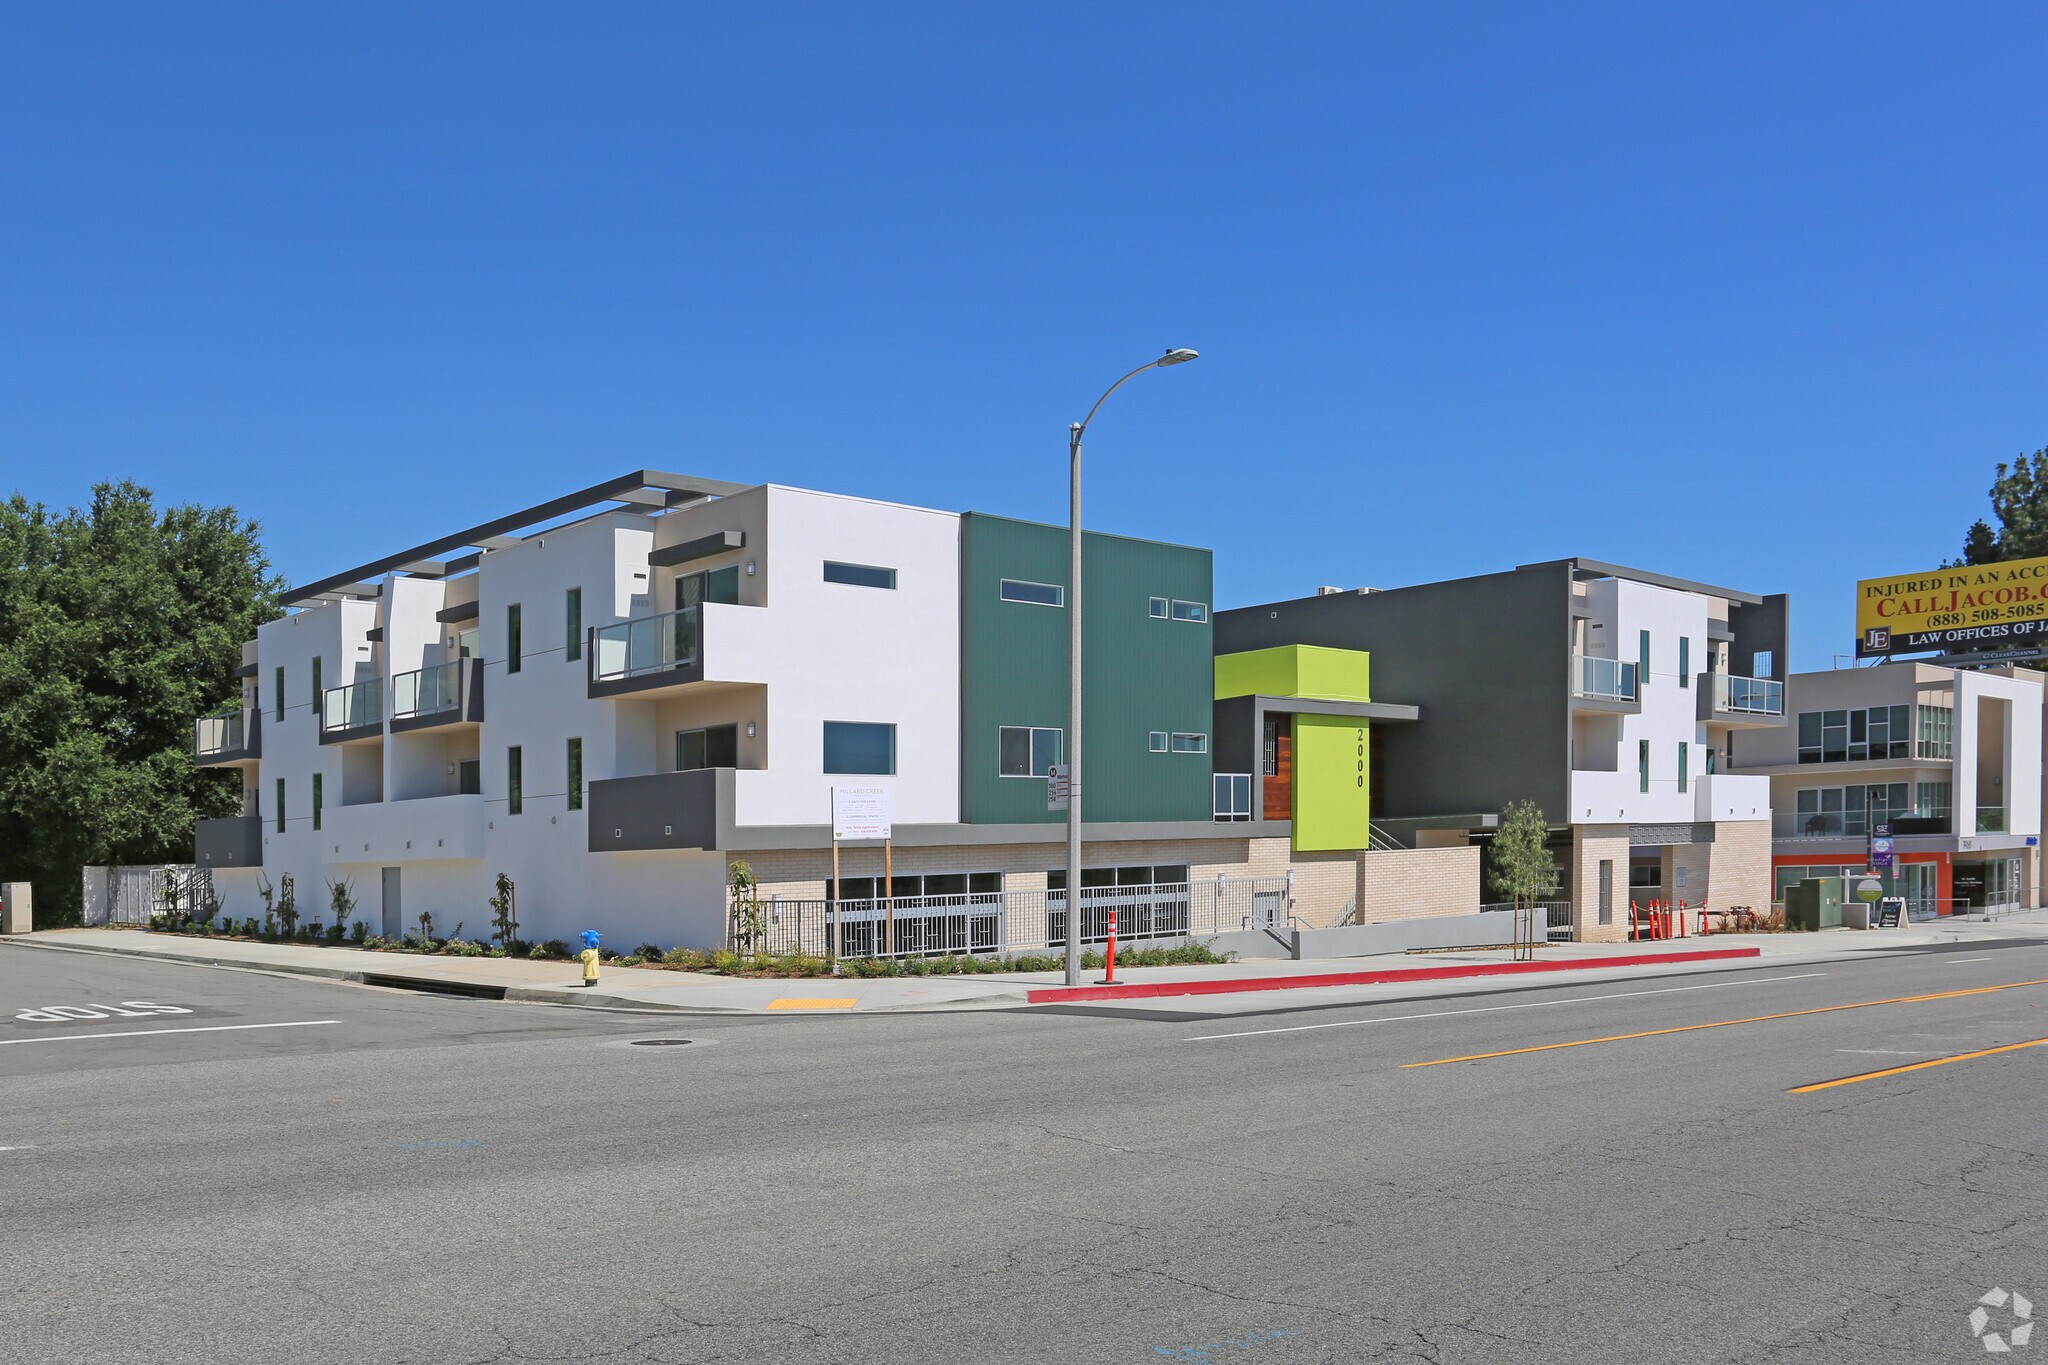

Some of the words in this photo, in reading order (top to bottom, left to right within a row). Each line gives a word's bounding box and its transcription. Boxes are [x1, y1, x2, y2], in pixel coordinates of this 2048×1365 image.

[1866, 579, 1942, 598] INJURED
[1949, 575, 1968, 588] IN
[1974, 571, 2000, 585] AN
[1926, 612, 1966, 629] (888)
[1971, 603, 2045, 623] 508-5085
[1908, 631, 1943, 645] LAW
[1946, 624, 2009, 642] OFFICES
[2013, 622, 2035, 635] OF
[15, 1001, 193, 1022] STOP
